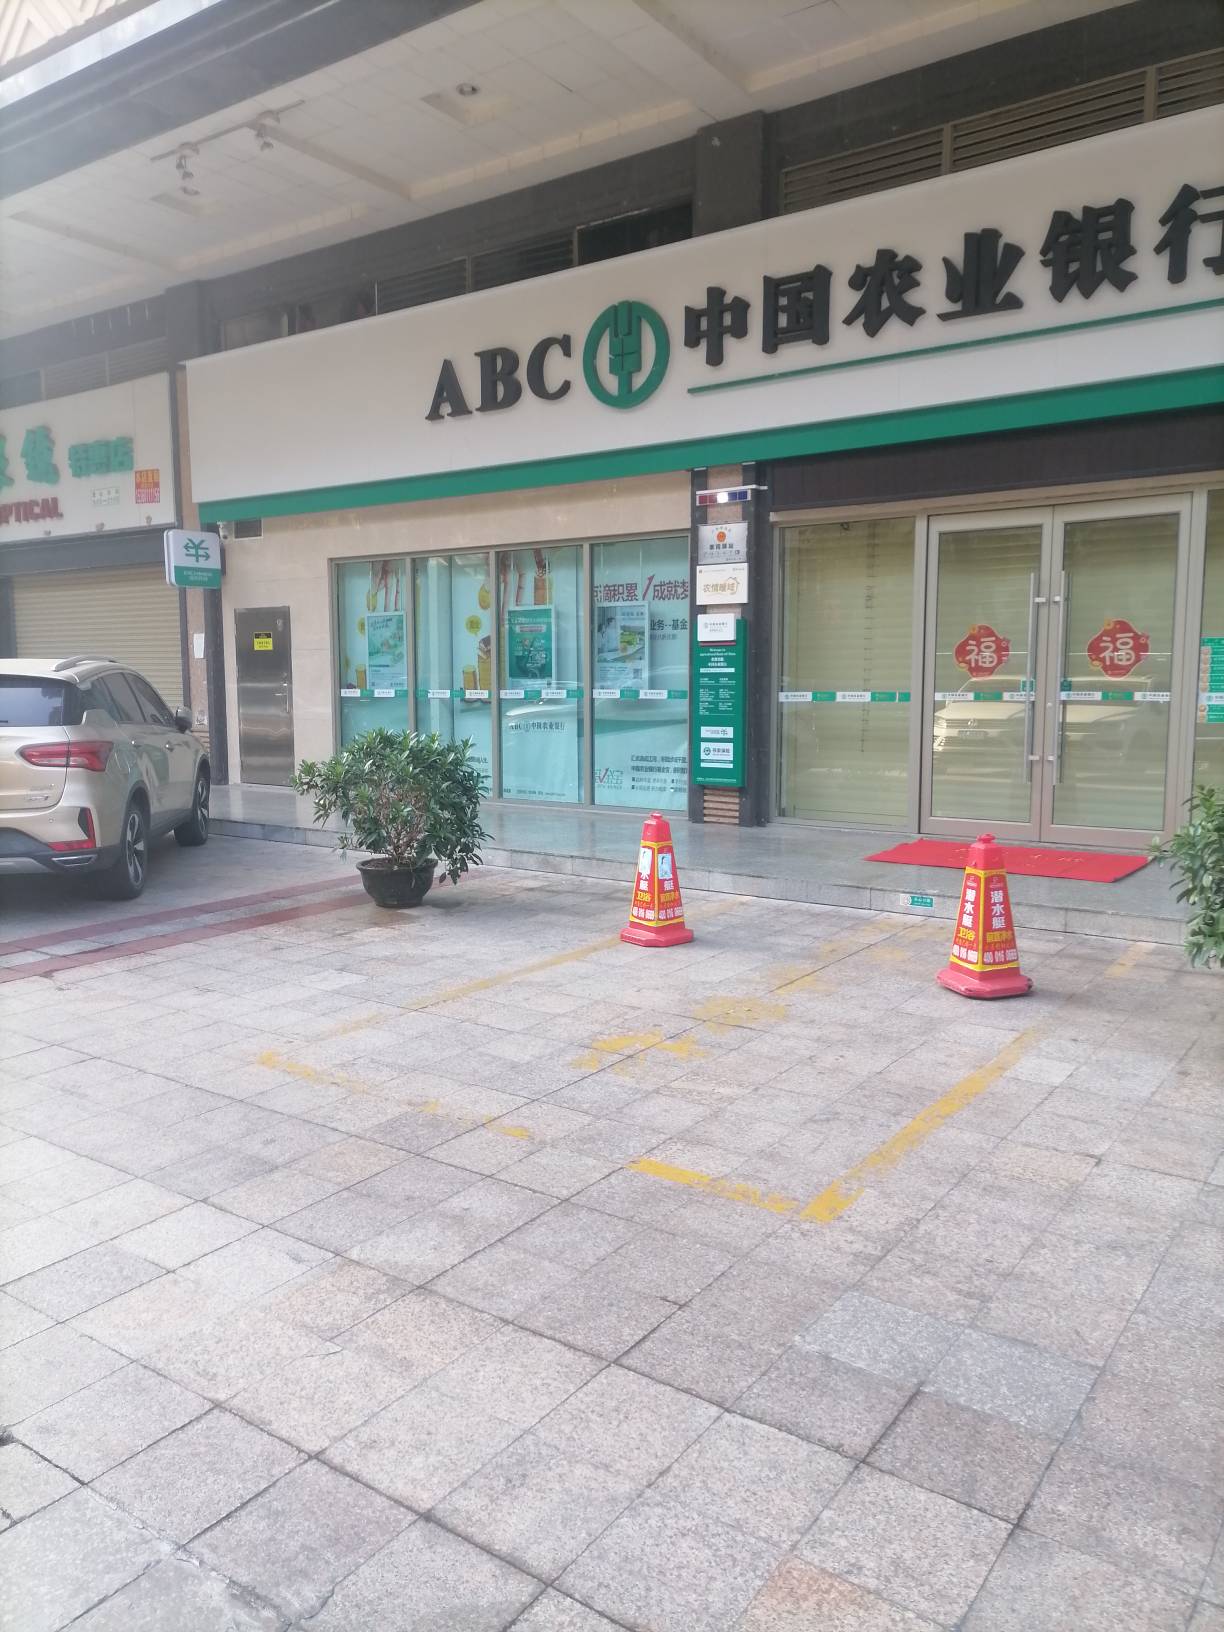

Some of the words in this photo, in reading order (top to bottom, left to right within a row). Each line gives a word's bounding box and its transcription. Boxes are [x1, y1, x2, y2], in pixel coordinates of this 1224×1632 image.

[683, 183, 1224, 368] 中国农业银行
[425, 333, 572, 422] ABC
[965, 636, 998, 667] 福
[1099, 632, 1136, 666] 福
